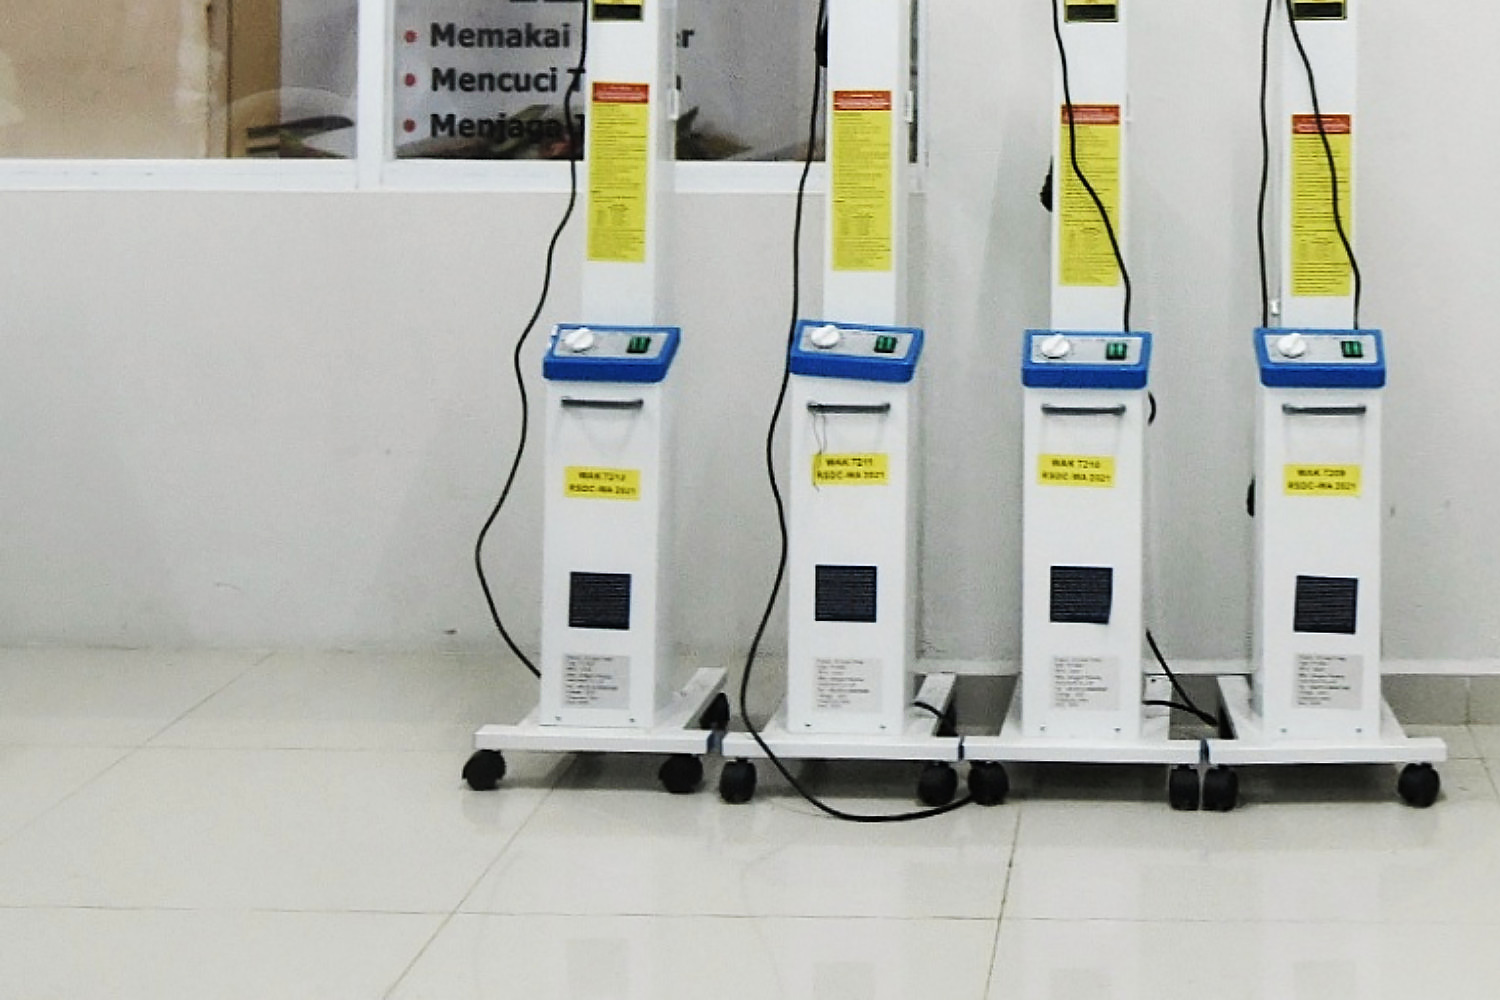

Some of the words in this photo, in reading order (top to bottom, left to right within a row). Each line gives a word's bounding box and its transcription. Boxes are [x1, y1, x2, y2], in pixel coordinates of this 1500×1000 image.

[430, 22, 571, 48] Memakai
[431, 67, 558, 93] Mencuci
[430, 114, 563, 144] Menjaga
